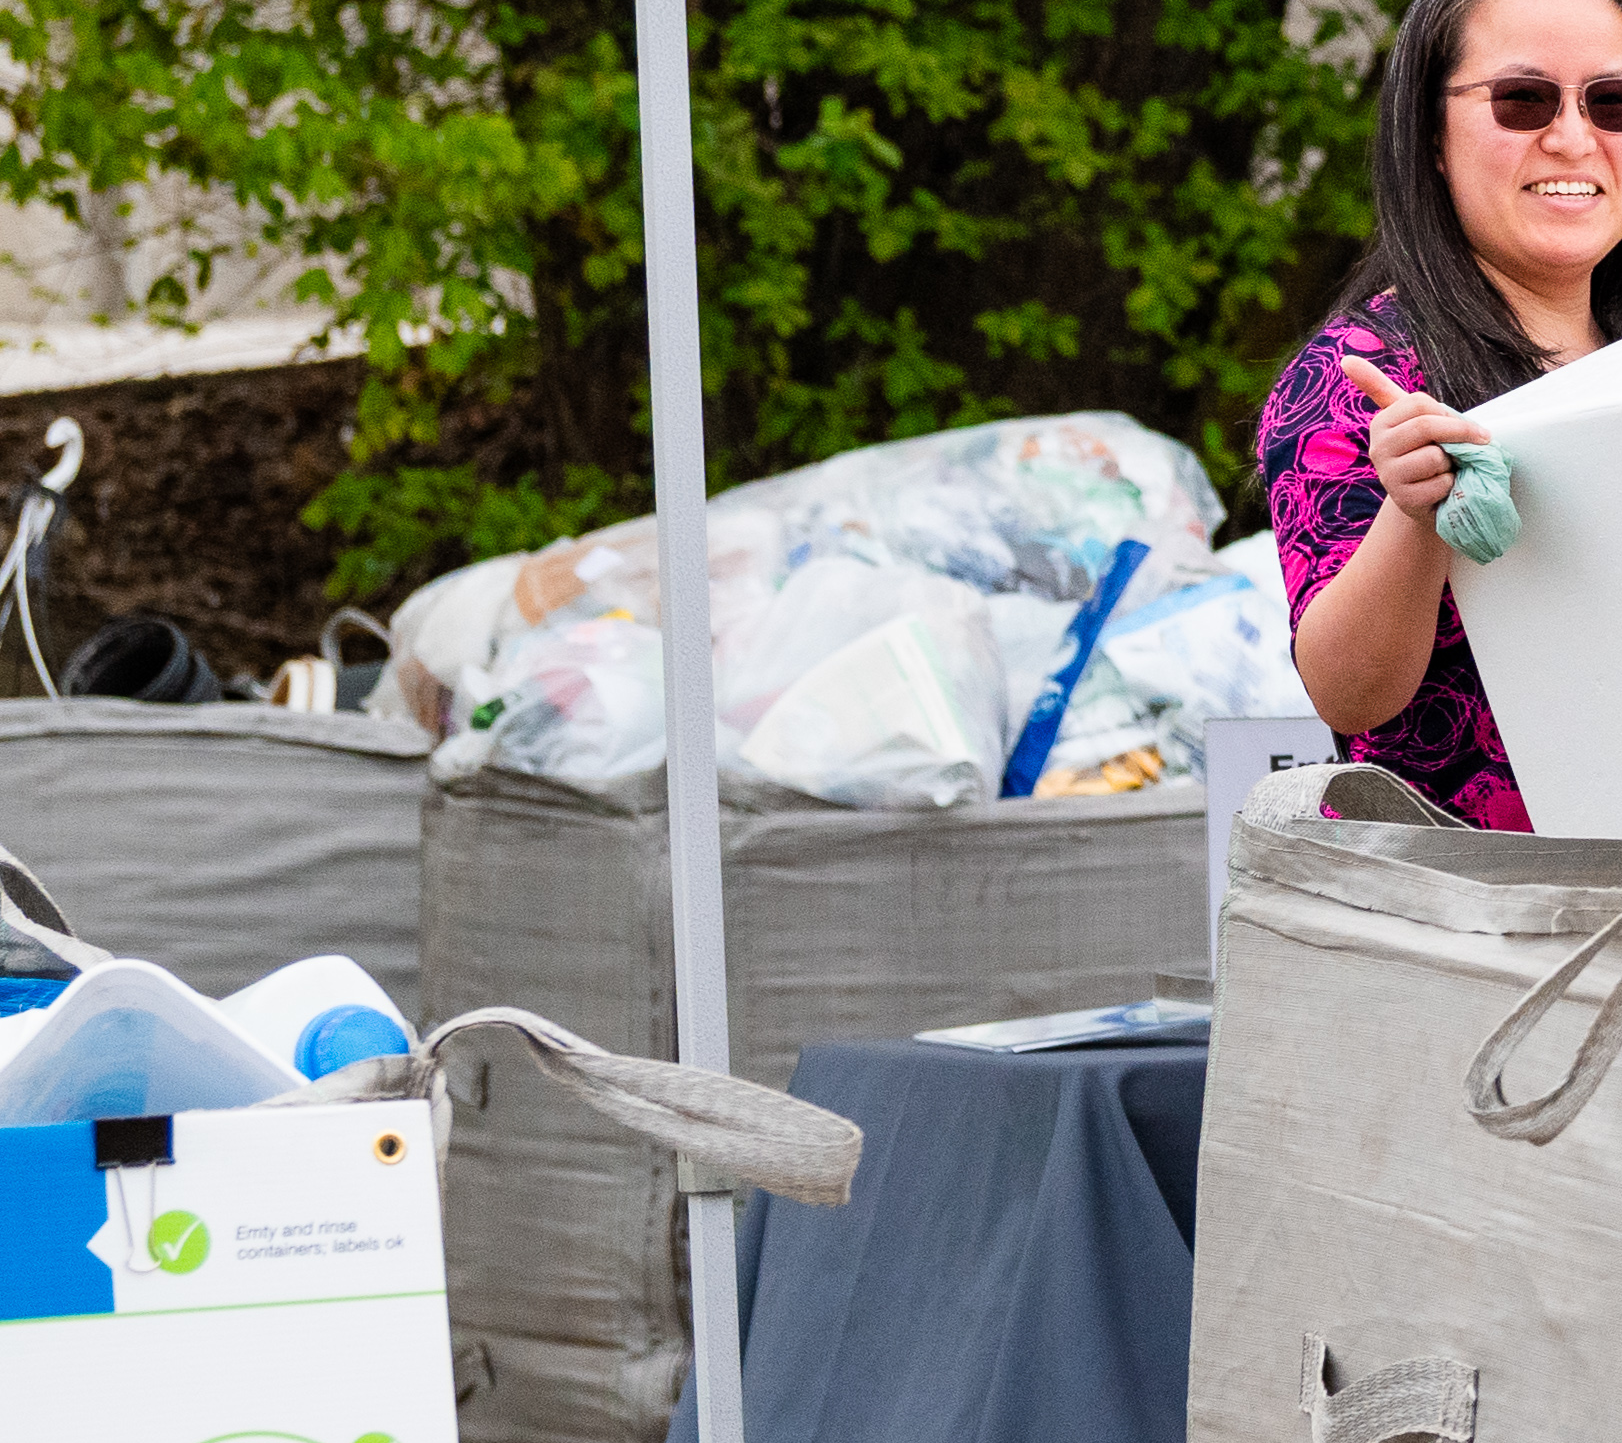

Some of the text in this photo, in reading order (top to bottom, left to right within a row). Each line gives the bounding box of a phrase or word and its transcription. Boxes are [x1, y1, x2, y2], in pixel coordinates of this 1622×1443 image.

[280, 1221, 314, 1239] and
[319, 1218, 358, 1235] rinse
[332, 1237, 380, 1253] labels
[385, 1234, 404, 1250] ok
